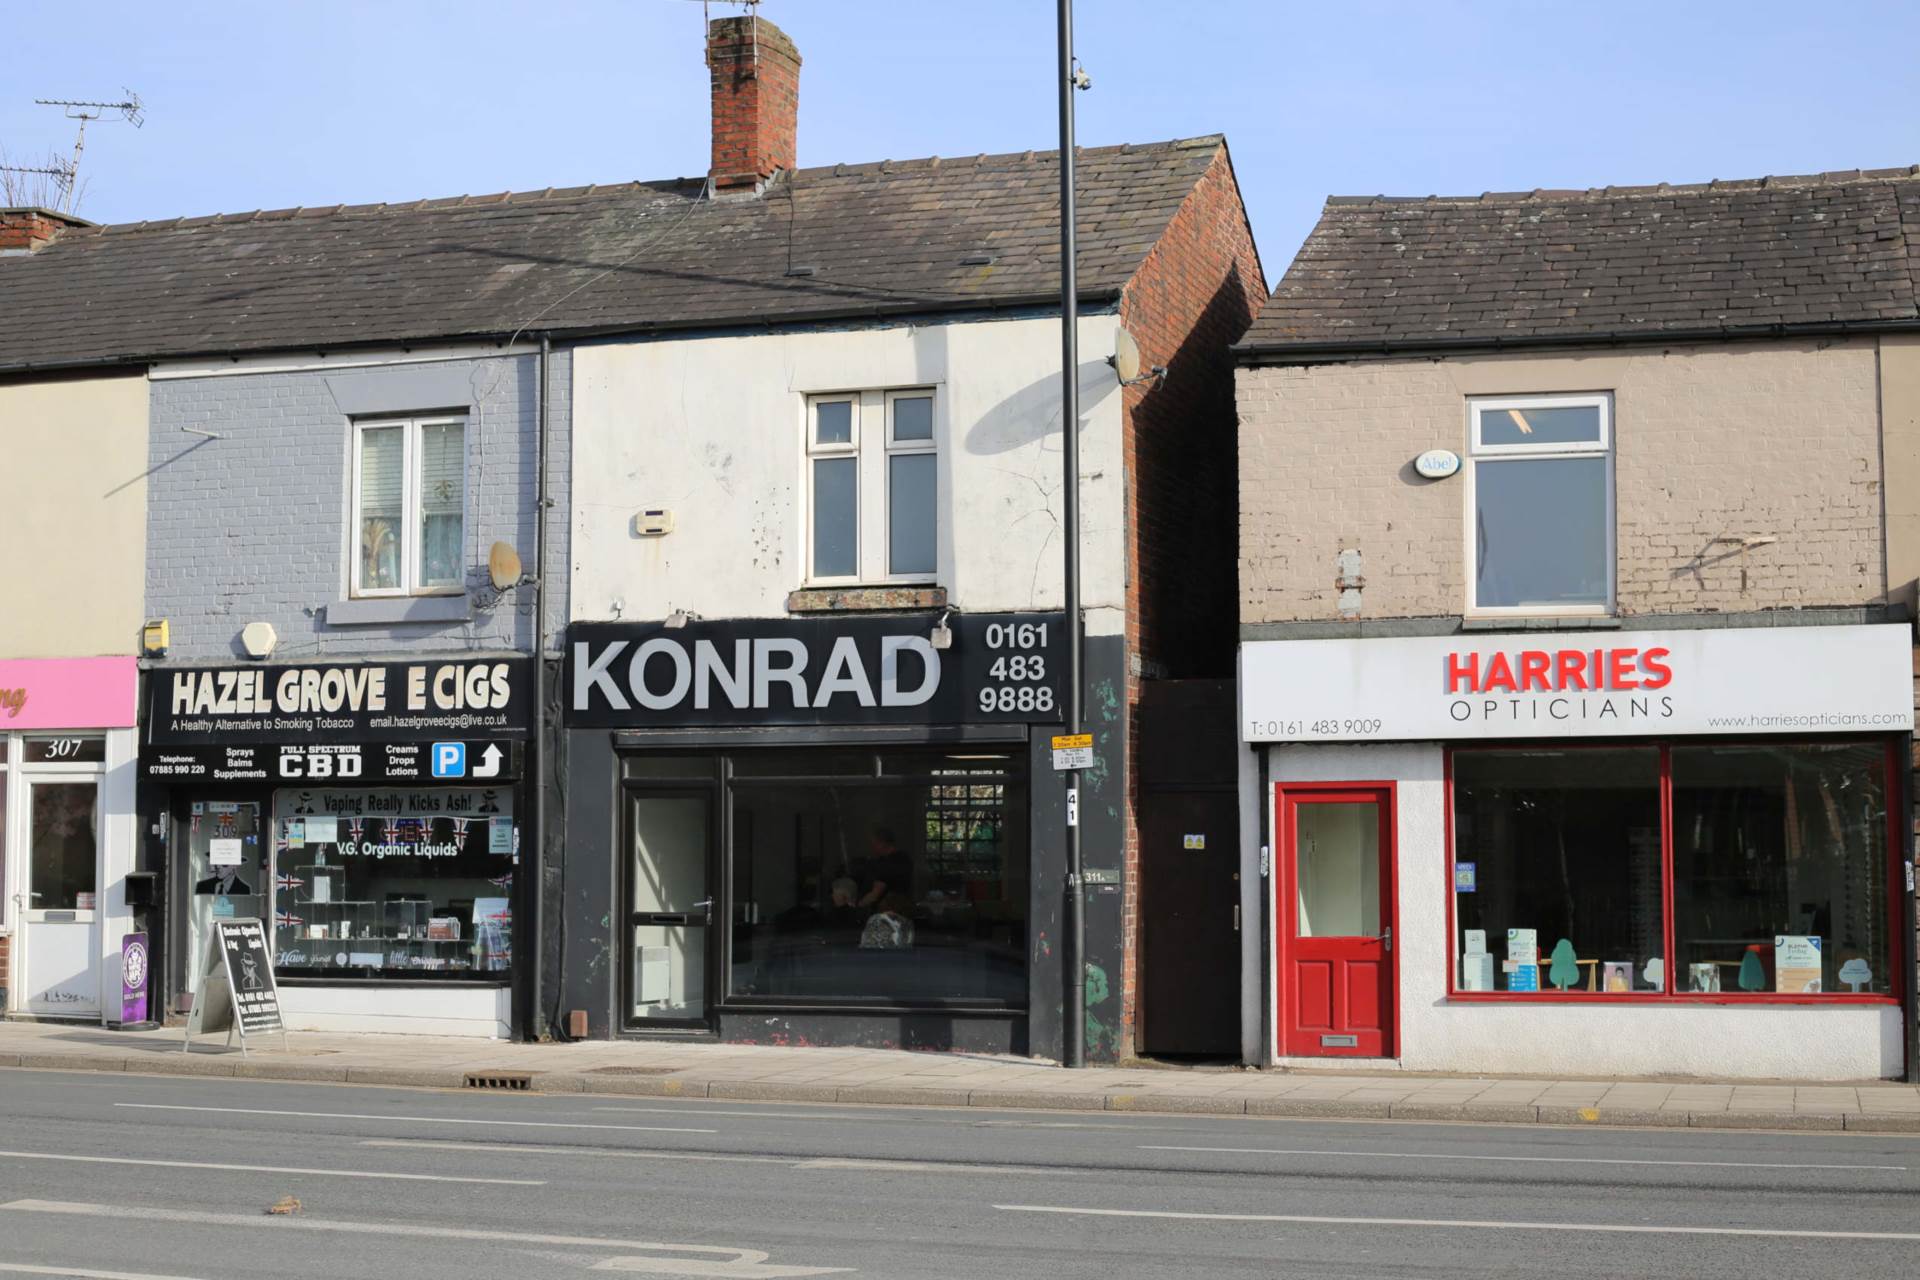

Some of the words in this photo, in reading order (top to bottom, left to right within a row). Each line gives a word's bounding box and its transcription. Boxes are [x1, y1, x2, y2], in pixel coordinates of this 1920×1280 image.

[985, 623, 1048, 649] 0161
[573, 635, 942, 711] KONRAD
[989, 655, 1046, 681] 483
[1448, 647, 1673, 693] HARRIES
[172, 670, 273, 715] HAZEL
[276, 667, 387, 713] GROVE
[407, 666, 427, 711] E
[433, 663, 511, 710] CIGS
[979, 686, 1054, 712] 9888
[1450, 696, 1674, 721] OPTICIANS
[171, 720, 179, 731] A
[180, 719, 213, 733] Healthy
[215, 718, 262, 731] Alternative
[263, 718, 273, 730] to
[274, 717, 313, 732] Smoking
[315, 717, 354, 729] Tobacco
[370, 713, 508, 730] email.hazelgroveecigs@live.co.uk
[1251, 721, 1264, 735] T:
[1267, 720, 1304, 735] 0161
[1311, 719, 1339, 734] 483
[1344, 719, 1382, 734] 9009
[1707, 711, 1907, 728] www.harriesopticians.com
[45, 739, 83, 759] 307
[226, 747, 254, 758] Sprays
[280, 746, 306, 754] FULL
[308, 745, 361, 754] SPECTRUM
[385, 745, 419, 754] Creams
[159, 755, 196, 764] Telephone:
[227, 758, 253, 768] Balms
[279, 754, 362, 777] CBD
[389, 756, 415, 766] Drops
[439, 746, 459, 774] P
[149, 765, 173, 775] 07885
[174, 765, 190, 774] 990
[191, 764, 205, 774] 220
[214, 768, 267, 780] Supplements
[386, 767, 419, 776] Lotions
[324, 794, 363, 815] Vaping
[367, 793, 403, 814] Really
[409, 794, 441, 811] Kicks
[446, 793, 472, 811] Ash!
[337, 842, 358, 855] V.G.
[362, 842, 411, 859] Organic
[414, 842, 458, 860] Liquids
